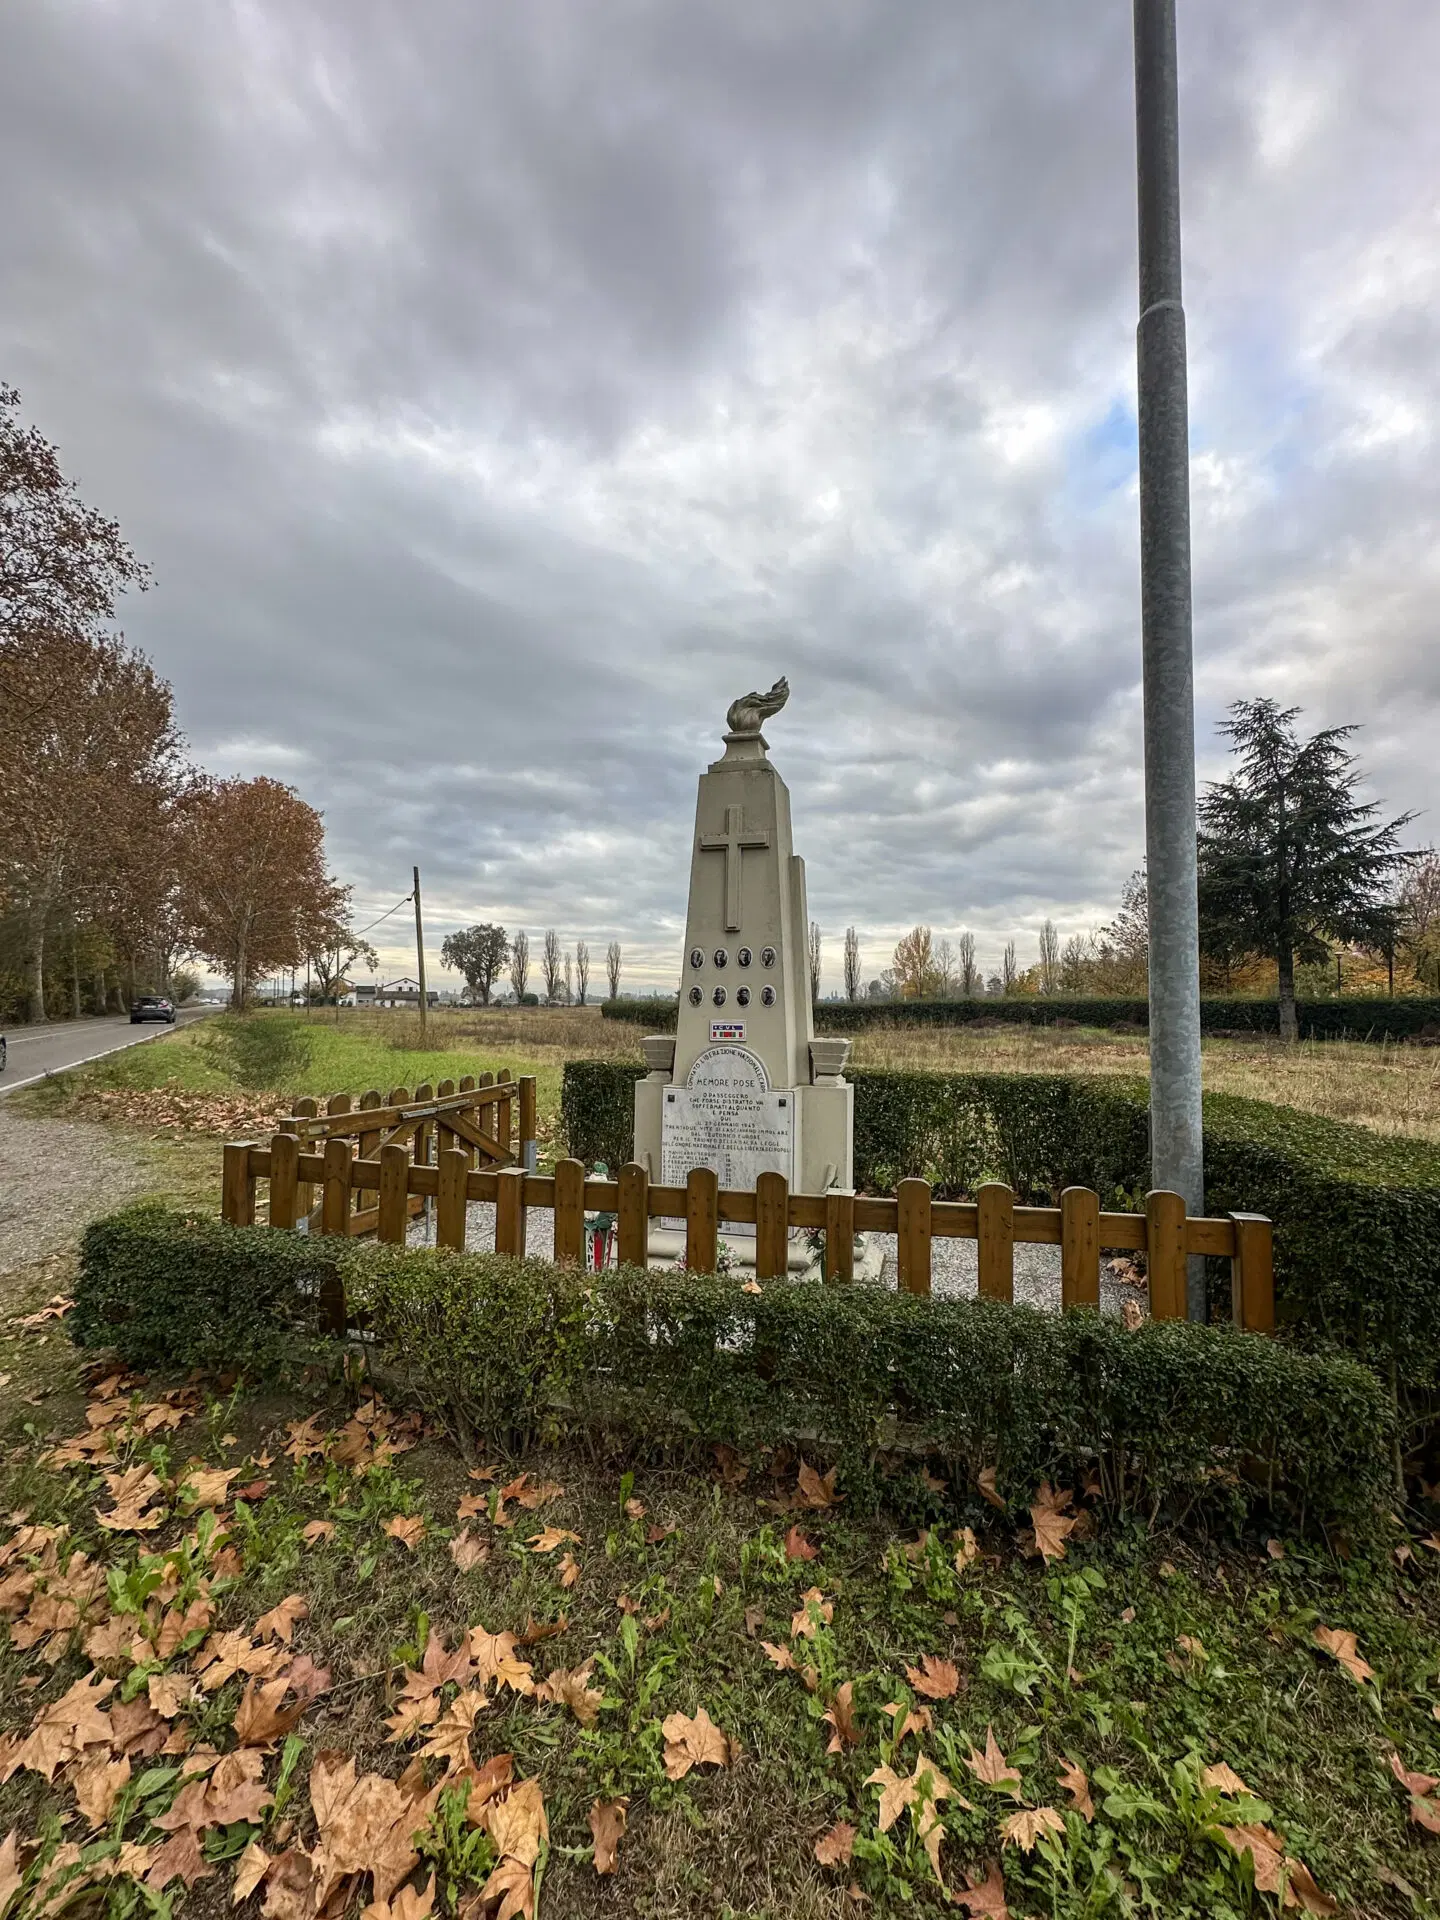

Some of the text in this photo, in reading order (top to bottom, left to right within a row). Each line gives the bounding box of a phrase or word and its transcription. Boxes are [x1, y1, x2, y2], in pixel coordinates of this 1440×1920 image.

[688, 1063, 700, 1090] COMITATO
[699, 1049, 737, 1064] LIBERAZIONE
[737, 1051, 762, 1077] NAZIONALE
[696, 1078, 755, 1088] MEMORE POSE
